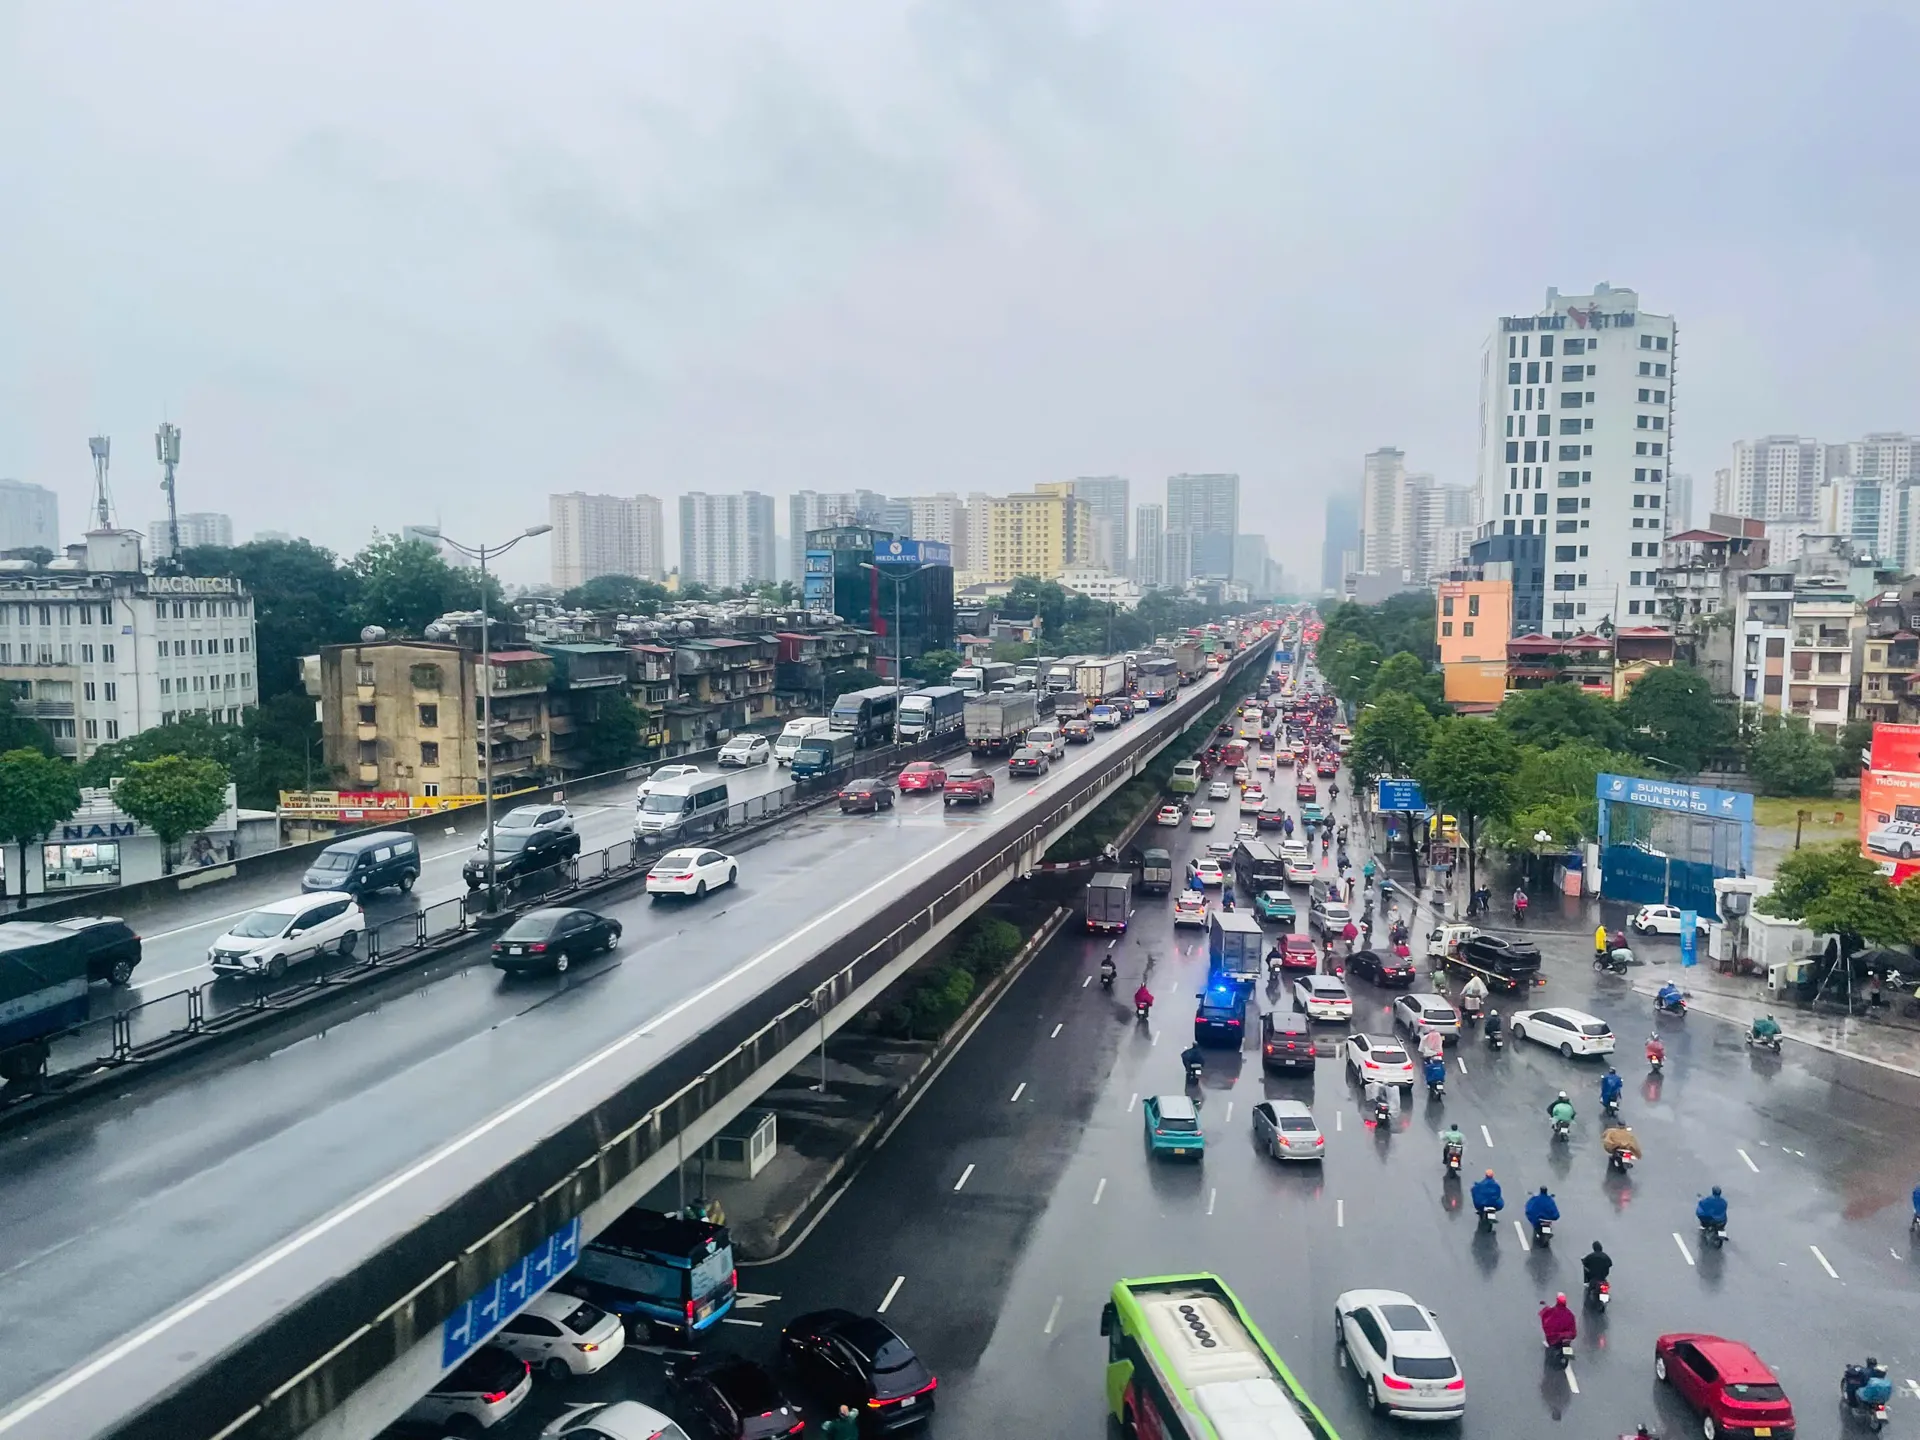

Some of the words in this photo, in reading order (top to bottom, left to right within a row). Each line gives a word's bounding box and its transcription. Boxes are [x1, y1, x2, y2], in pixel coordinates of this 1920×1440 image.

[1875, 777, 1907, 788] THÔNG
[1637, 783, 1700, 800] SUNSHINE
[1630, 792, 1707, 811] BOULEVARD
[63, 822, 135, 839] NAM
